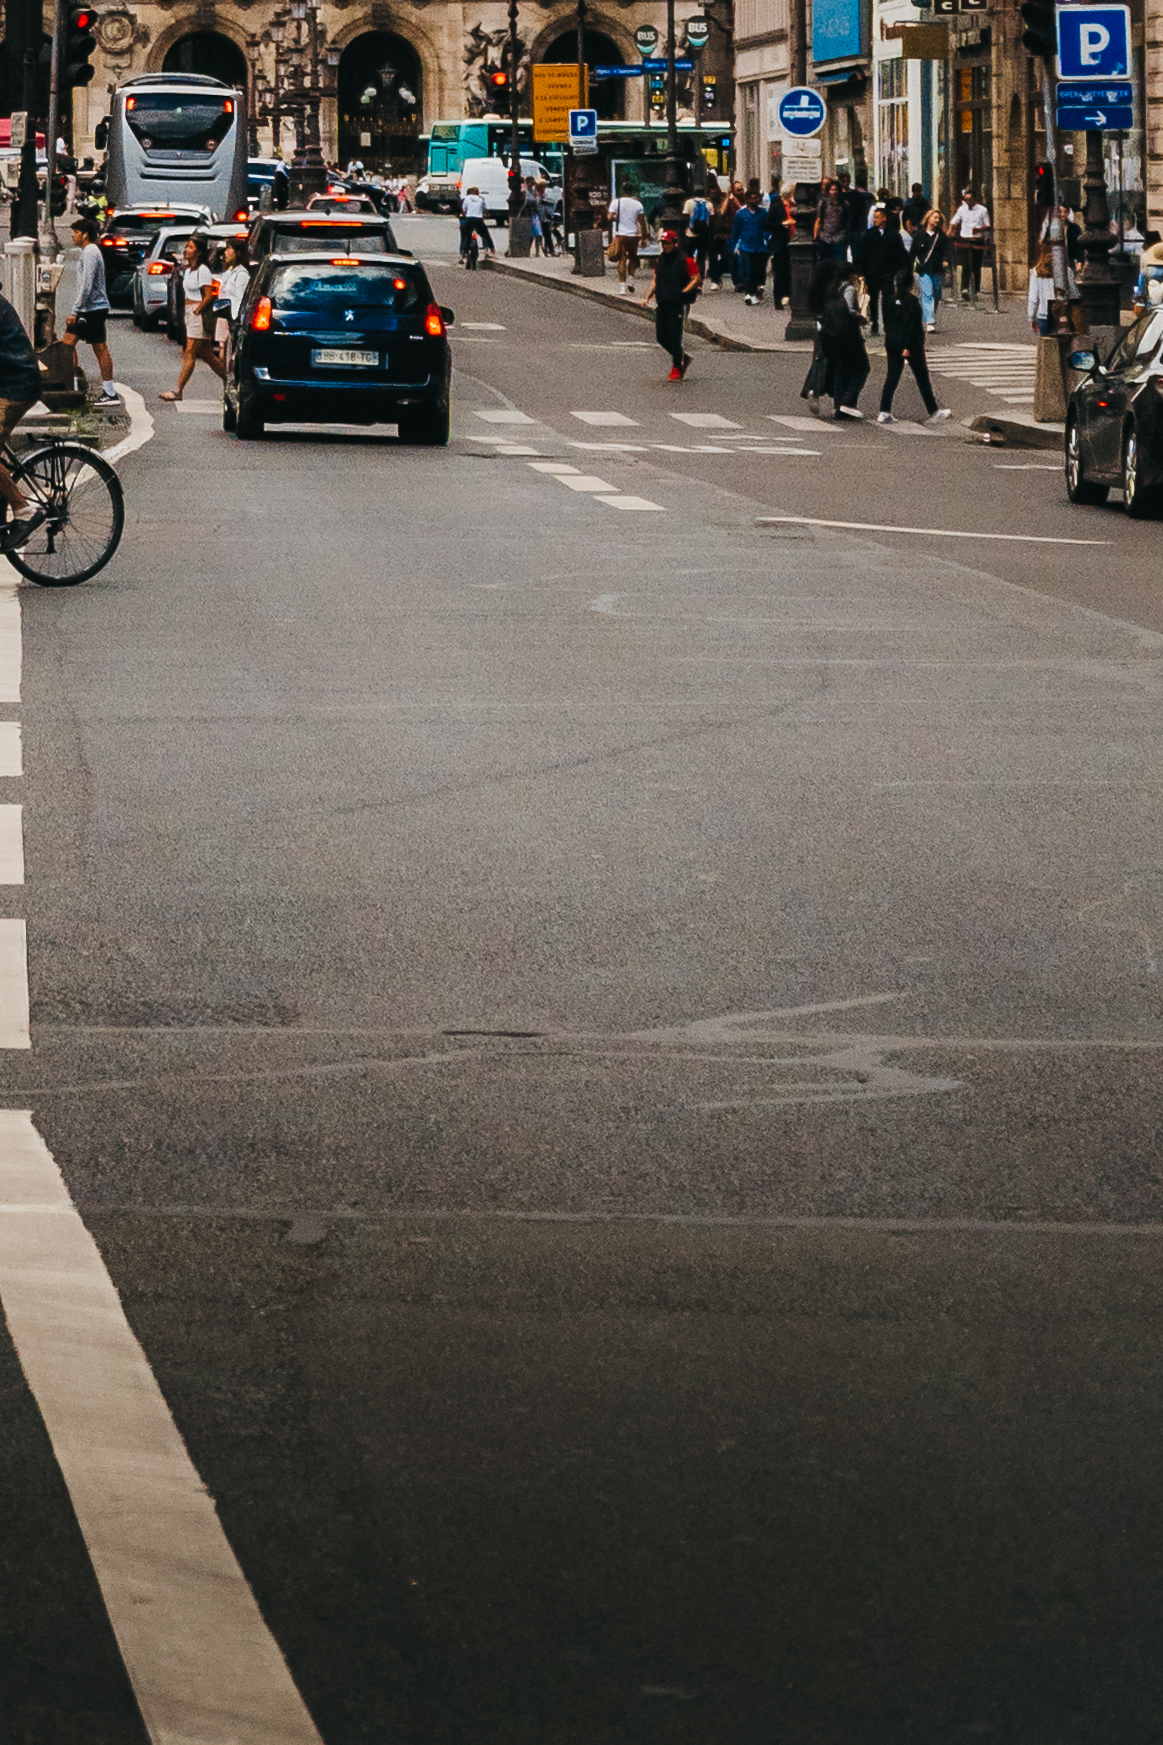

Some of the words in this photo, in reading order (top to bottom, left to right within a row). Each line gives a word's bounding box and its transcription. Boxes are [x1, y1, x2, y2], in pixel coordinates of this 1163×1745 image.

[688, 22, 708, 33] BUS
[637, 31, 656, 41] BUS
[1079, 23, 1110, 65] P
[577, 115, 589, 132] P
